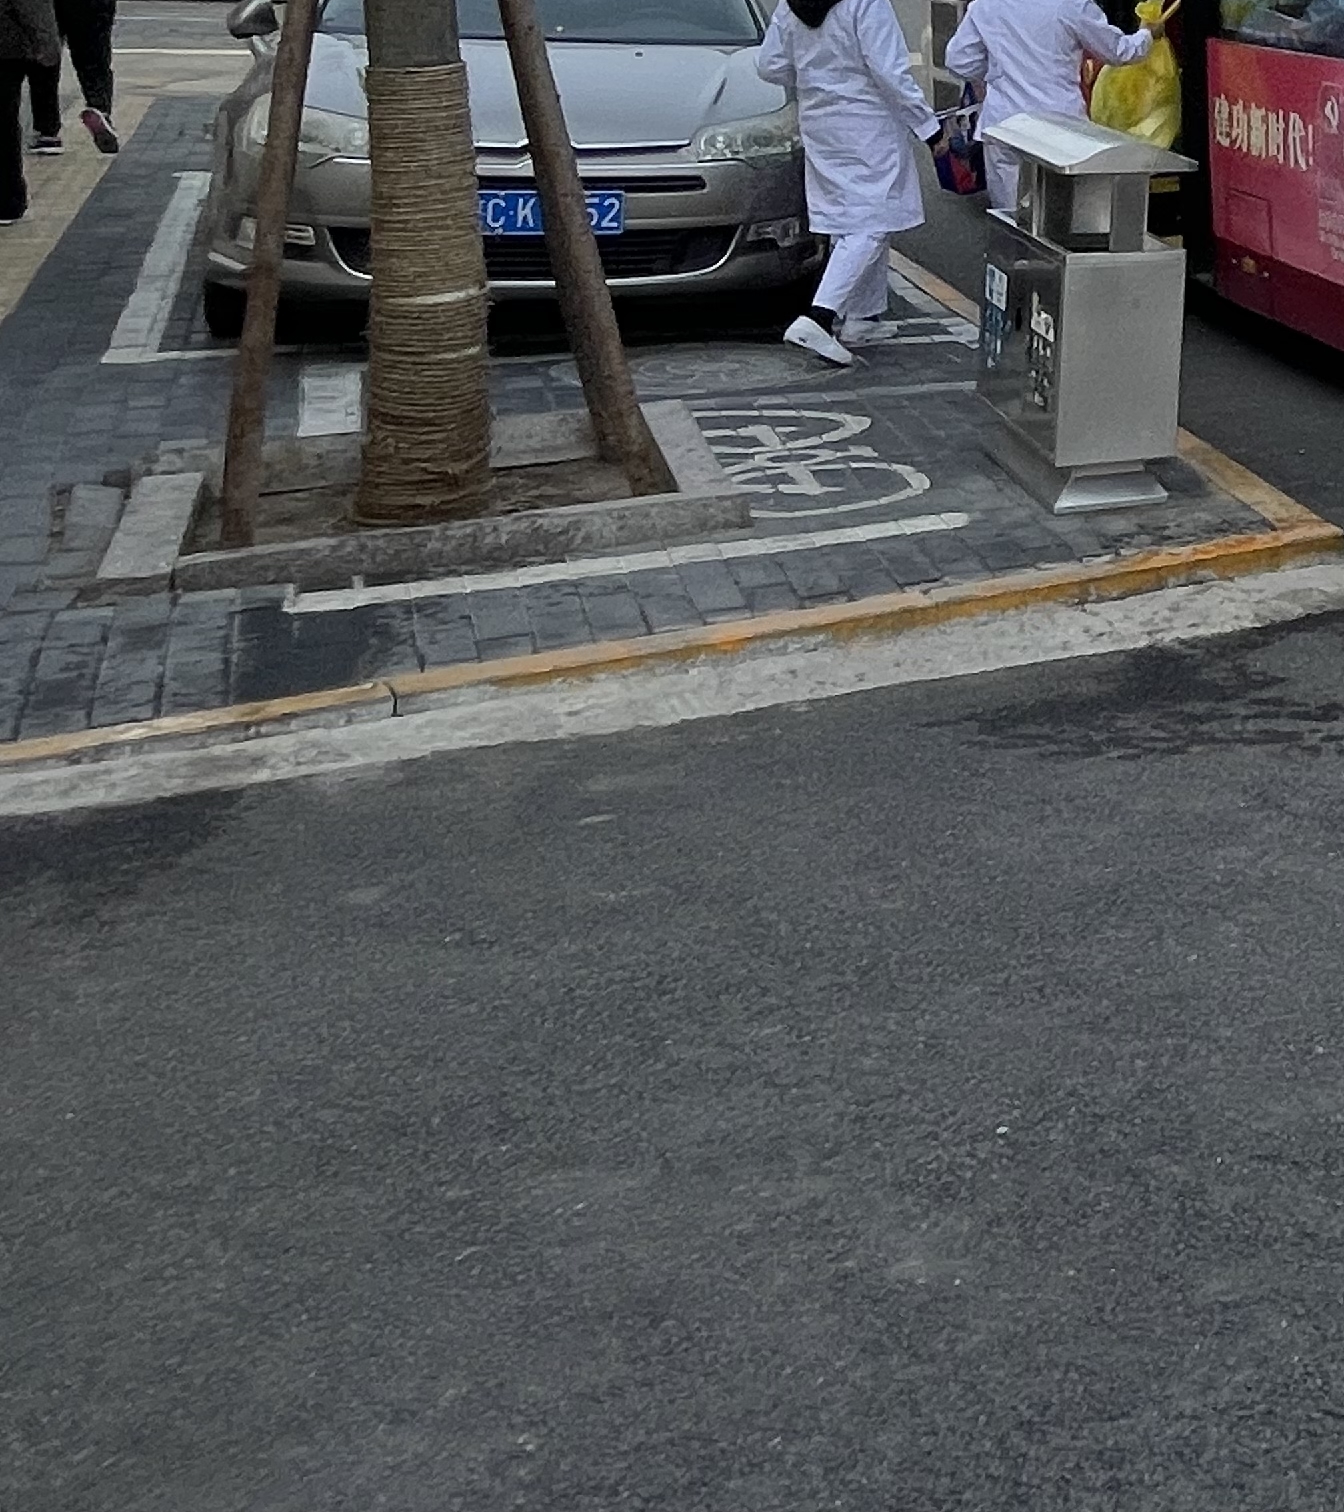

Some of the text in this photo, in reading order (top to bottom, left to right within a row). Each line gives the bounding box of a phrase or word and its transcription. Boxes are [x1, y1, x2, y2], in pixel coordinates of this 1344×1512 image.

[1215, 93, 1314, 172] 建功新时代!
